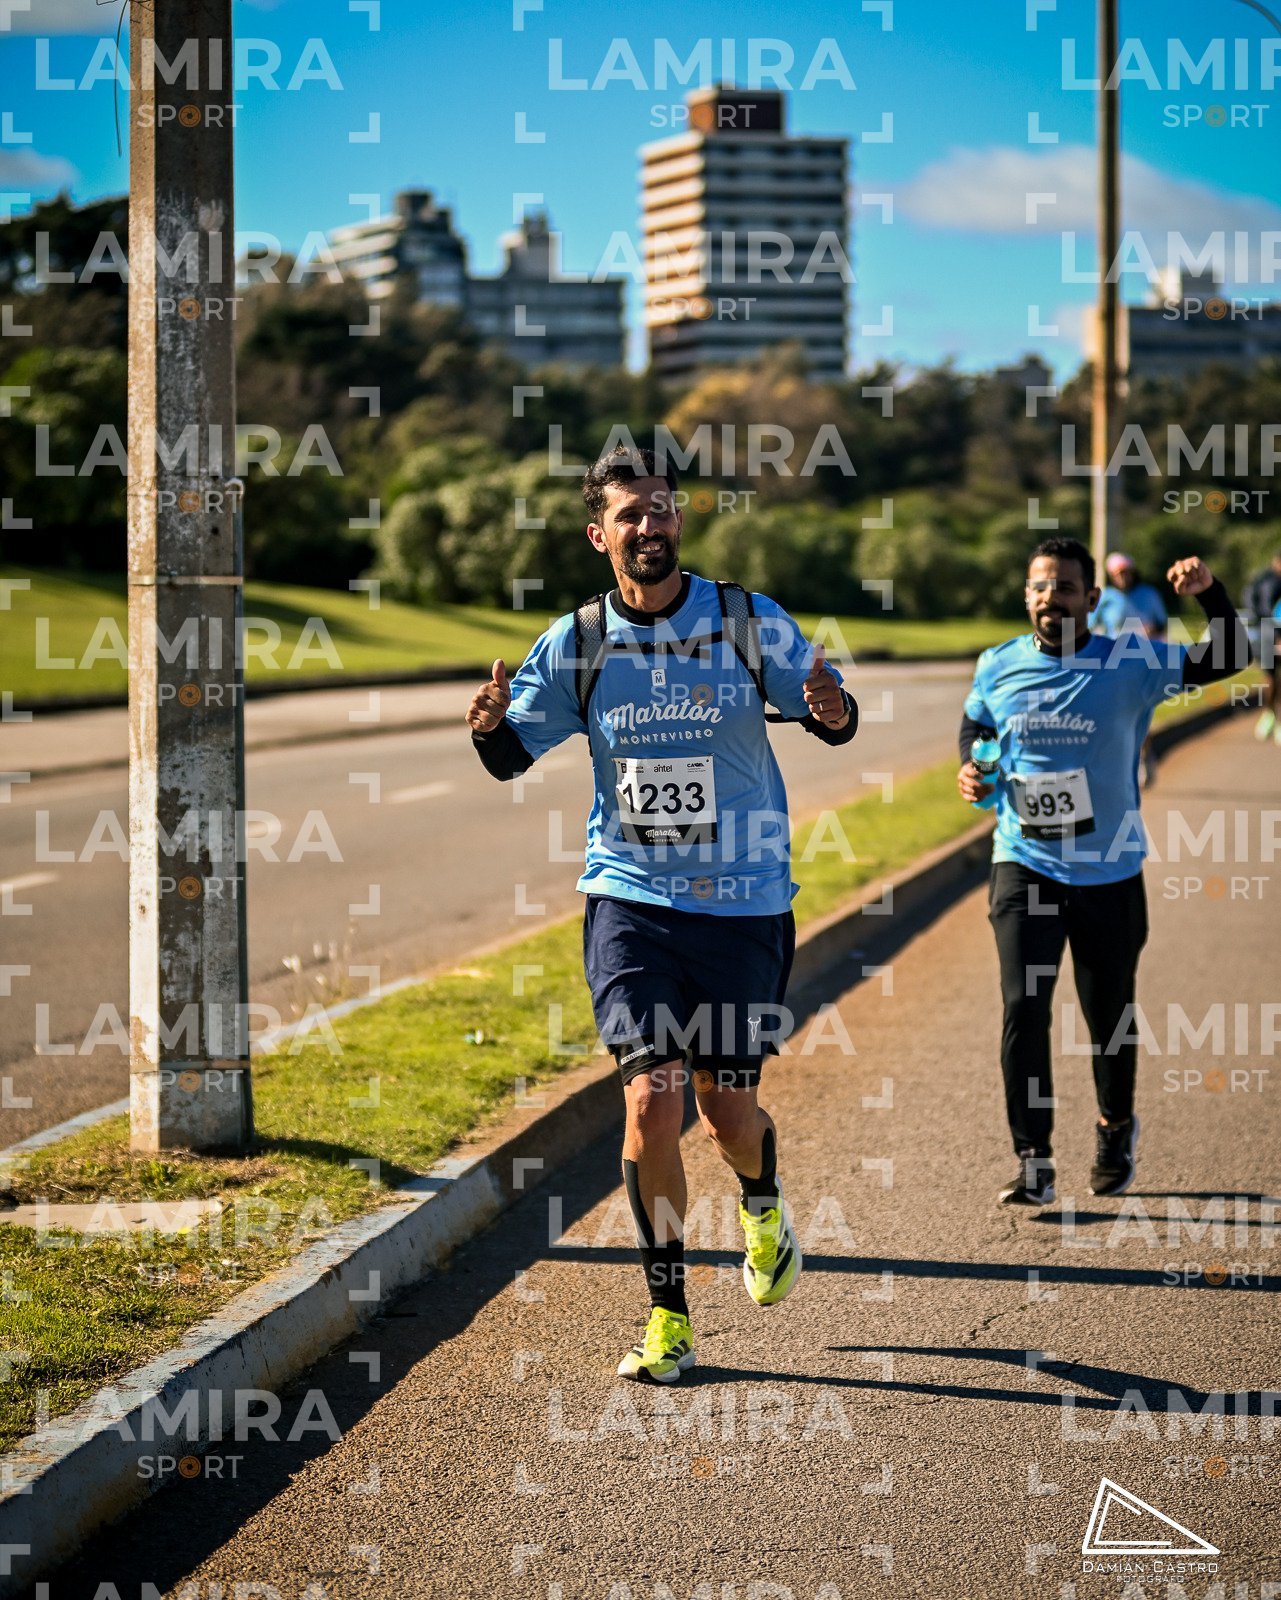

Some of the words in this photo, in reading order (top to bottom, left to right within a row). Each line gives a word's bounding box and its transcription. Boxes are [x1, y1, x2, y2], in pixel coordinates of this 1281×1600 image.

[606, 699, 723, 731] Maratón
[1006, 712, 1097, 736] Maratón
[619, 728, 714, 745] MONTEVIDEO
[653, 764, 673, 773] antel
[622, 782, 706, 814] 1233
[1025, 791, 1075, 818] 993
